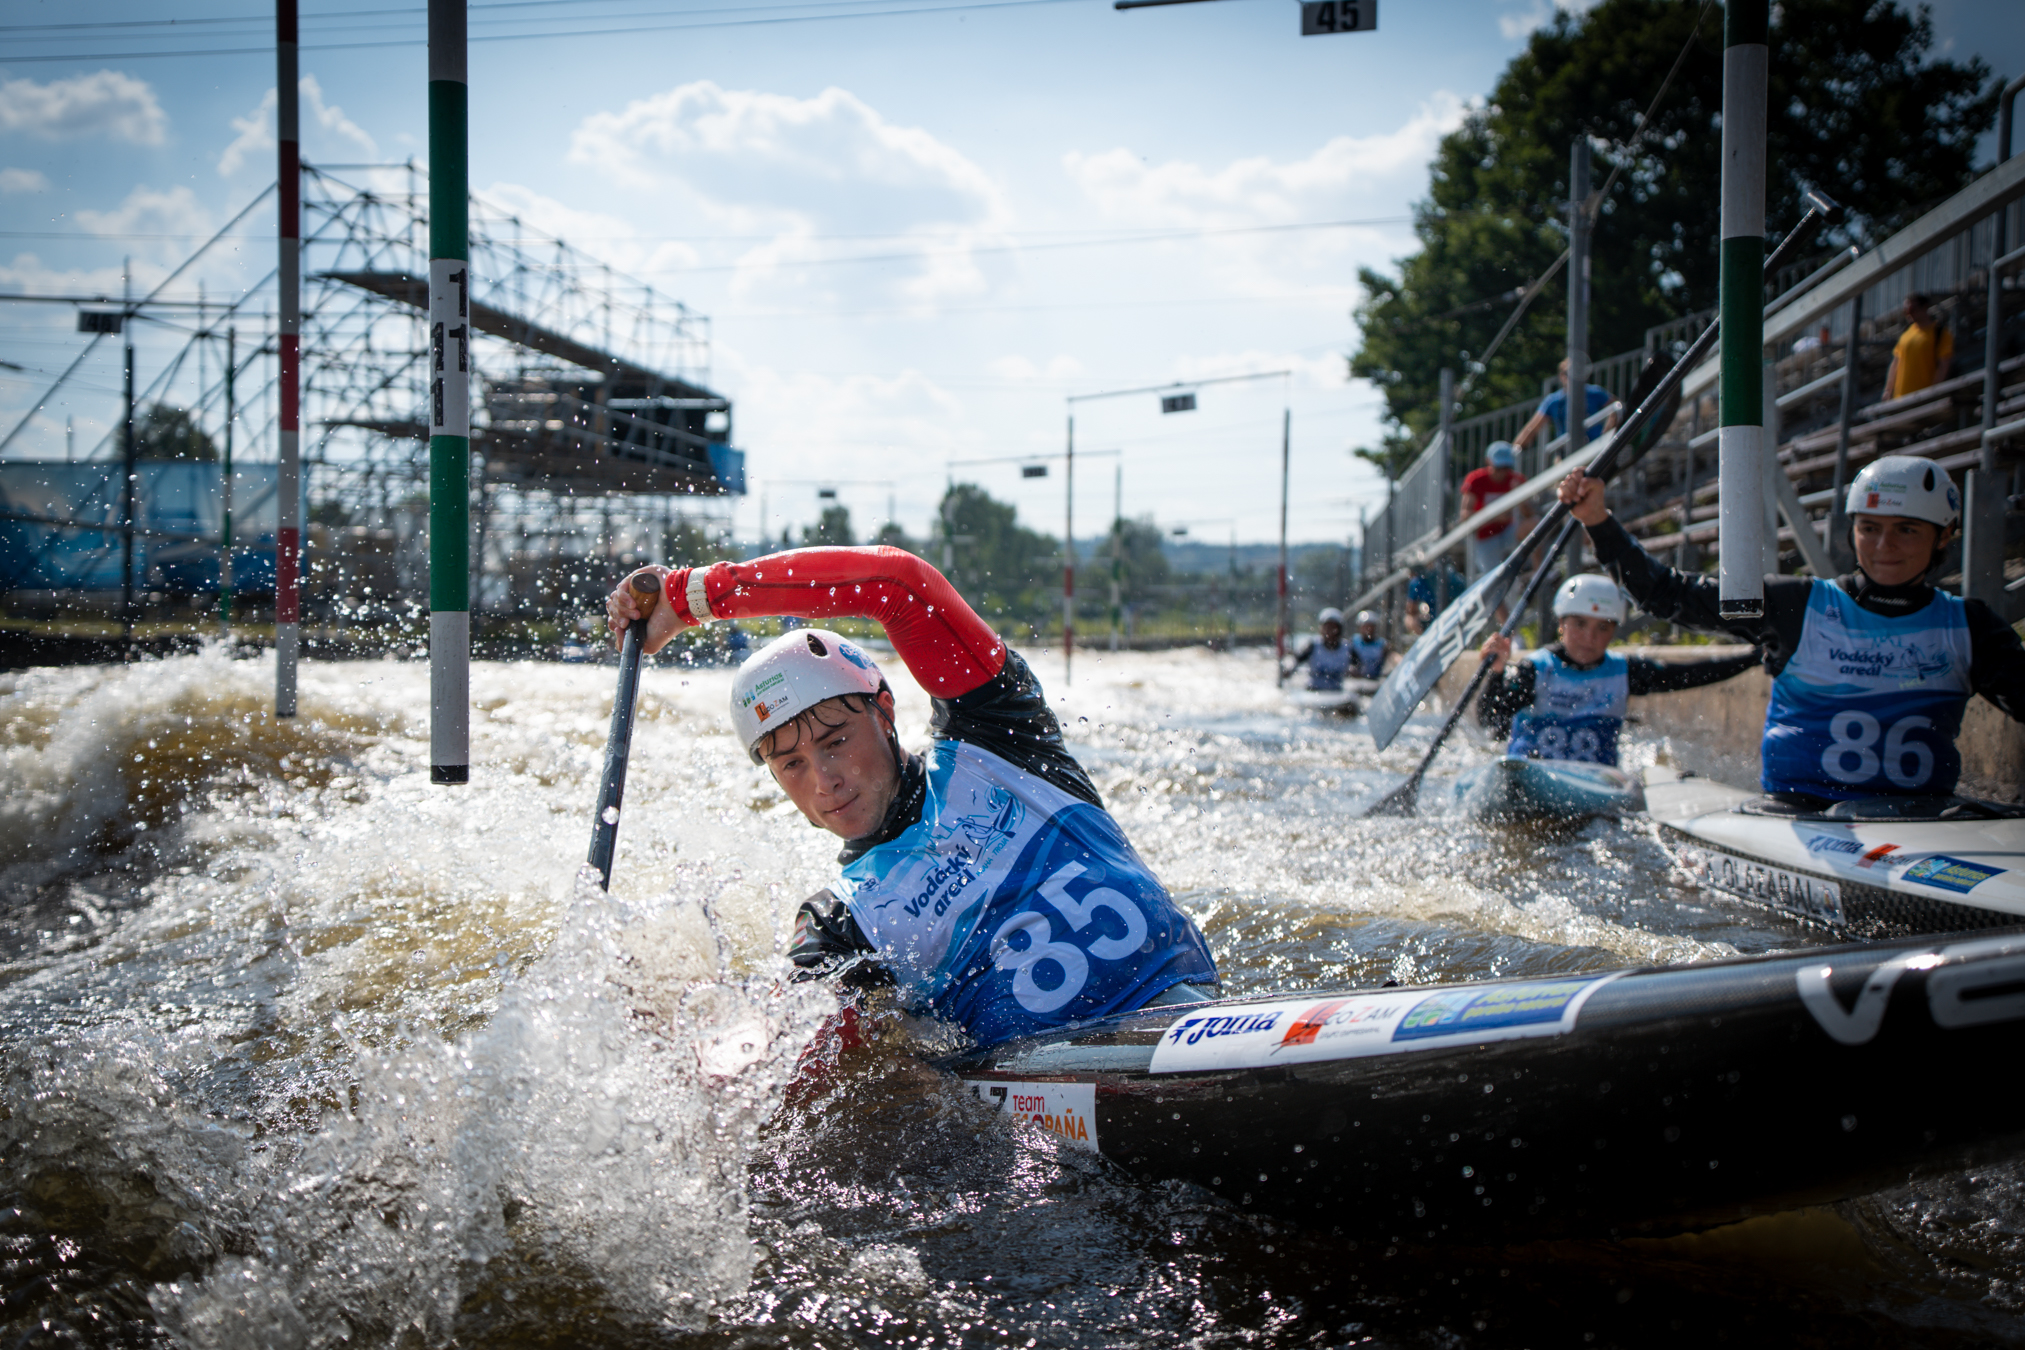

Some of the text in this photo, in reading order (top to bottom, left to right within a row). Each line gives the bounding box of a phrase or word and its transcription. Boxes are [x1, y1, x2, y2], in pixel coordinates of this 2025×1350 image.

[1316, 0, 1358, 32] 45
[1829, 648, 1894, 667] Vodácký
[755, 672, 783, 692] Asturias
[1839, 664, 1881, 676] areál
[1821, 710, 1934, 788] 86
[994, 837, 1010, 857] TROJA
[903, 844, 972, 918] Vodácký
[1942, 863, 1992, 881] Asturias
[934, 868, 976, 917] areál
[990, 860, 1148, 1013] 85
[1476, 981, 1588, 1005] Asturias
